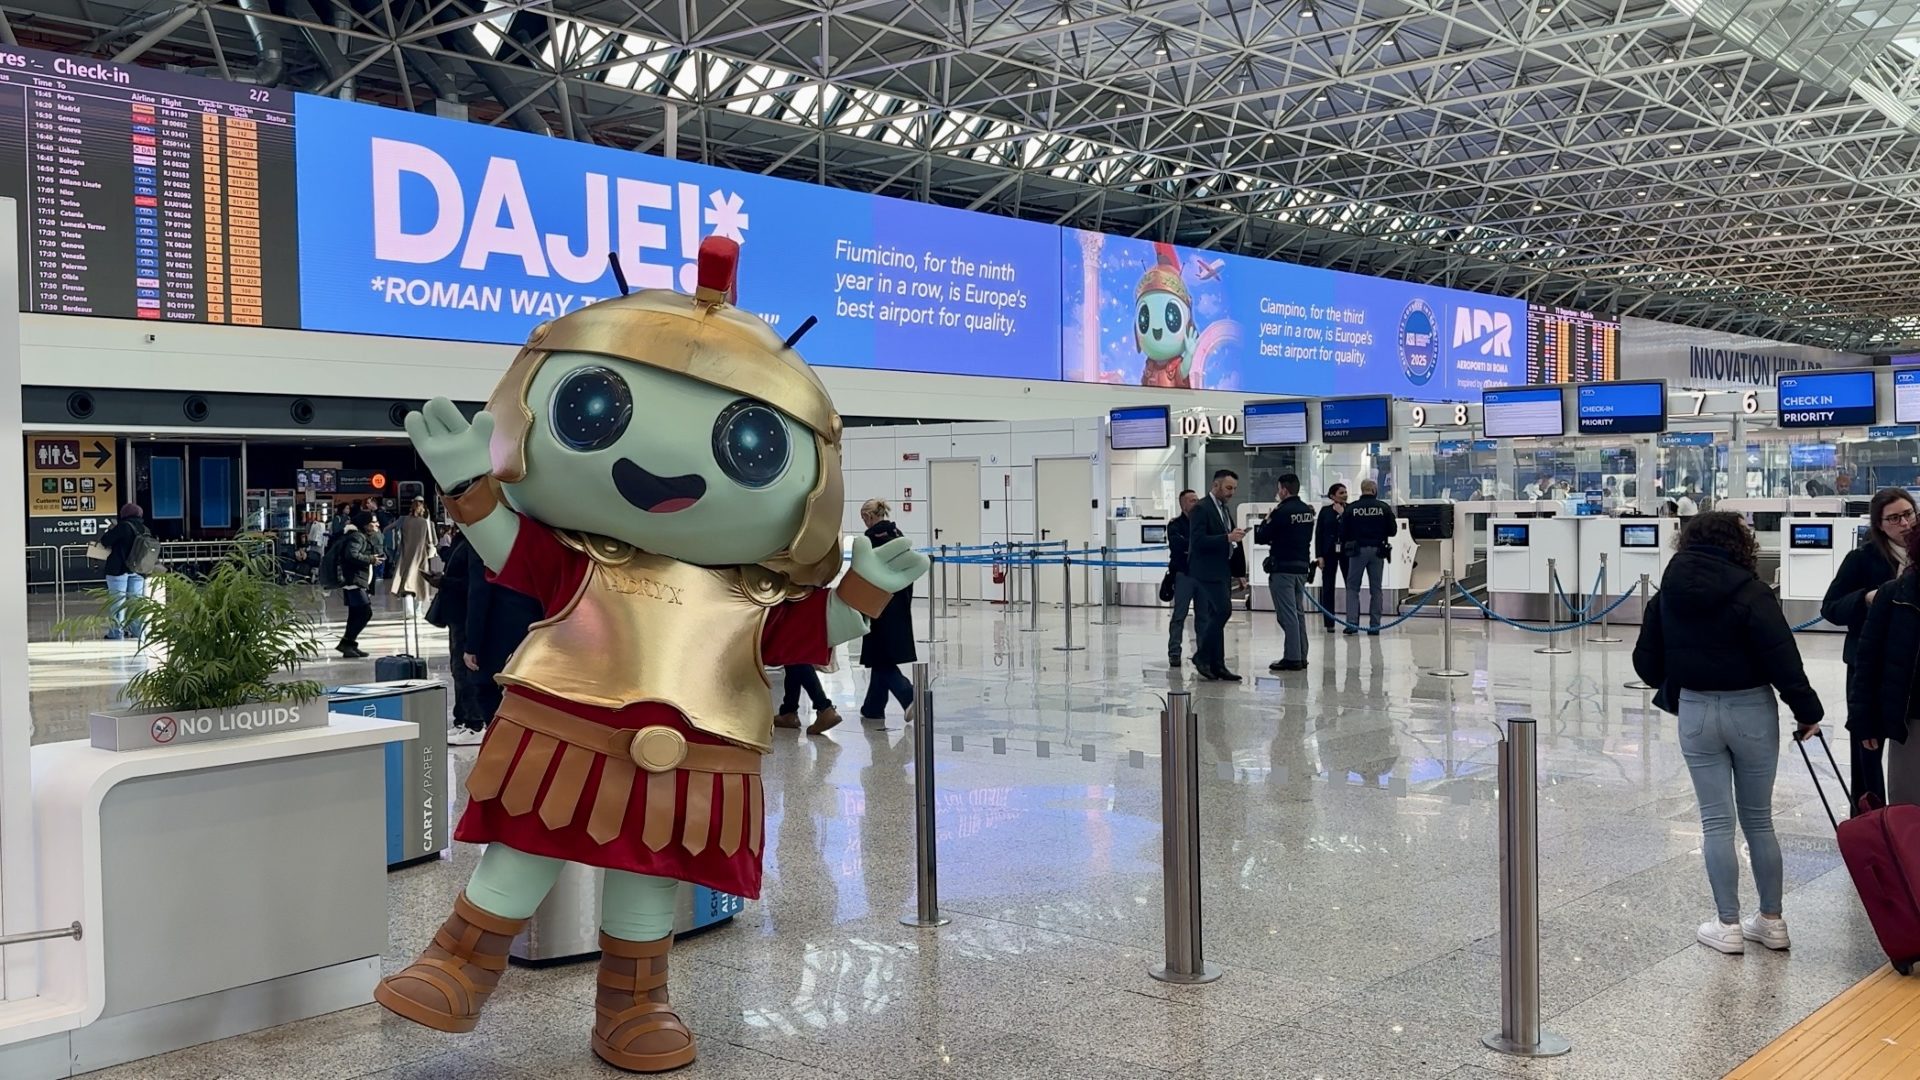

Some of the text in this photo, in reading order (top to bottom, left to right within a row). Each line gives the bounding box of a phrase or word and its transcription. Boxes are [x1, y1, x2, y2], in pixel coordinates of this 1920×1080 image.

[54, 58, 129, 83] Check-in
[33, 78, 52, 87] Time
[57, 81, 66, 90] To
[132, 93, 182, 108] Airline Flight
[250, 89, 269, 102] 2/2
[57, 104, 80, 112] Madrid
[57, 114, 80, 123] Geneva
[266, 114, 286, 123] Status
[58, 125, 81, 133] Geneva
[58, 157, 84, 166] Bologna
[836, 240, 1015, 282] Fiumicino, for the ninth
[834, 273, 1026, 309] year in a row, is Europe's
[510, 288, 569, 316] WAY
[1260, 297, 1364, 325] Ciampino, for the third
[836, 296, 1016, 336] best airport for quality.
[1259, 322, 1281, 337] year
[1284, 322, 1292, 336] in
[1295, 327, 1301, 338] a
[1303, 327, 1323, 342] row,
[1325, 326, 1333, 341] is
[1453, 306, 1512, 357] ADR
[1260, 340, 1366, 367] best airport for quality.
[1411, 354, 1427, 366] 2025
[1457, 360, 1486, 372] AEROPORTI
[1492, 363, 1508, 373] ROMA
[1690, 346, 1770, 386] INNOVATION
[1691, 393, 1706, 416] 7
[1742, 391, 1757, 414] 6
[1784, 395, 1832, 406] CHECK IN
[1217, 415, 1236, 434] 10
[1412, 406, 1425, 427] 9
[1454, 404, 1468, 426] 8
[1784, 412, 1834, 422] PRIORITY
[1353, 507, 1384, 516] POLIZIA
[180, 706, 300, 736] NO LIQUIDS
